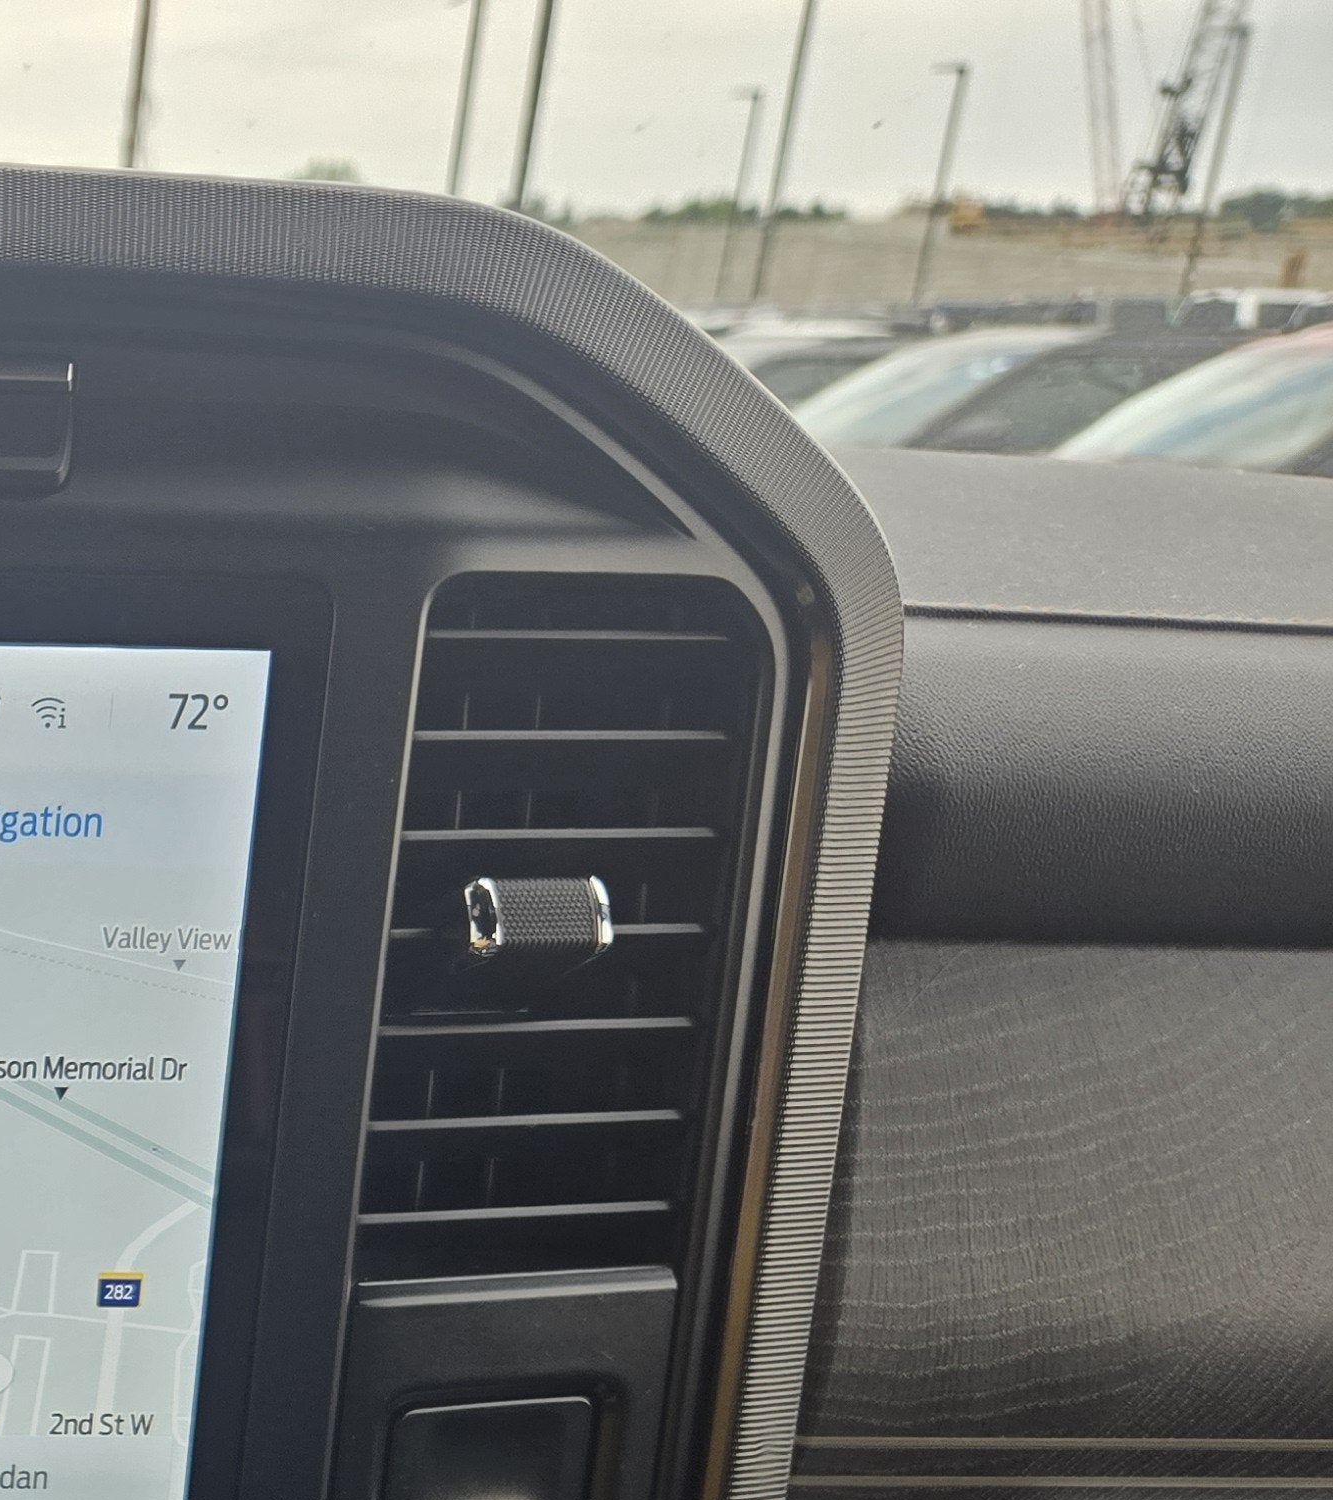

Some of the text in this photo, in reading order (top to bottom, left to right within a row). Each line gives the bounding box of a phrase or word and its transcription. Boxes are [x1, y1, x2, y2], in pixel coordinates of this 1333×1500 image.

[102, 926, 232, 953] Valley View
[44, 1056, 156, 1081] Memorial
[162, 1057, 188, 1082] Dr
[104, 1283, 134, 1301] 282
[49, 1412, 154, 1436] 2nd St W
